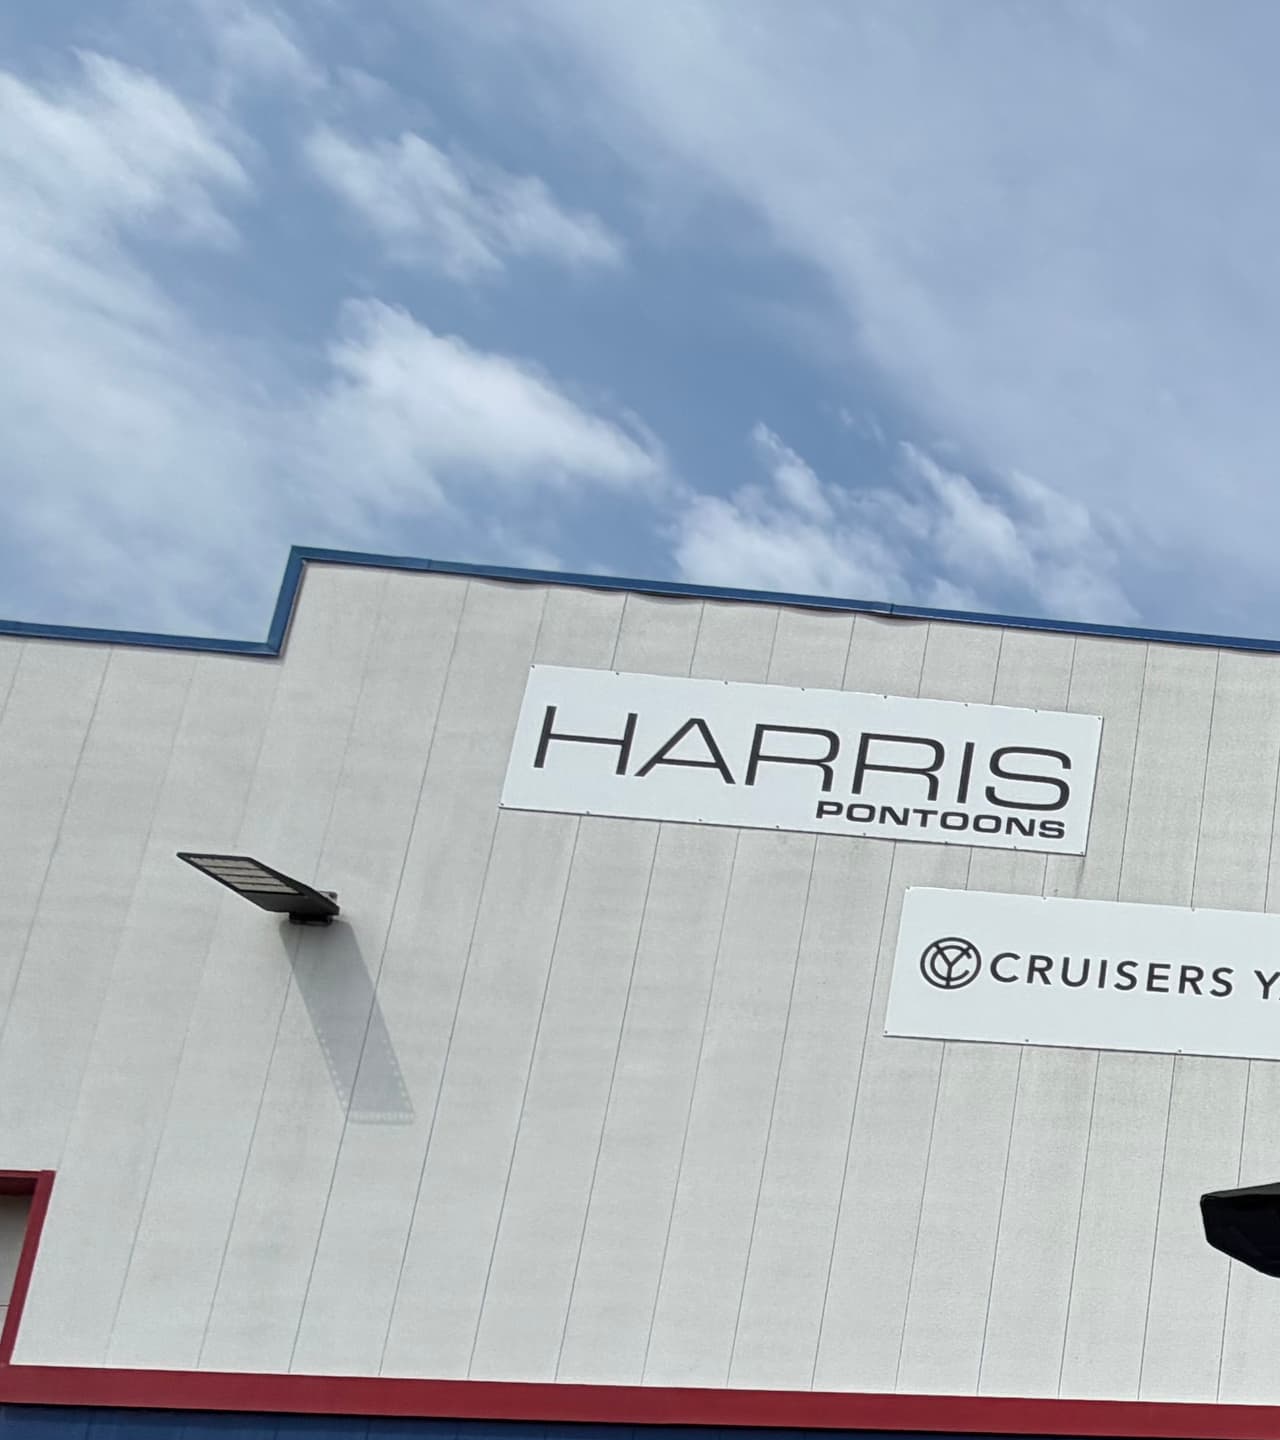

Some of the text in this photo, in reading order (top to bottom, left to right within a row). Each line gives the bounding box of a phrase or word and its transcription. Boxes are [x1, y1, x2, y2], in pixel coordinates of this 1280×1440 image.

[533, 705, 1072, 812] HARRIS
[815, 800, 1066, 840] PONTOONS
[989, 952, 1234, 998] CRUISERS
